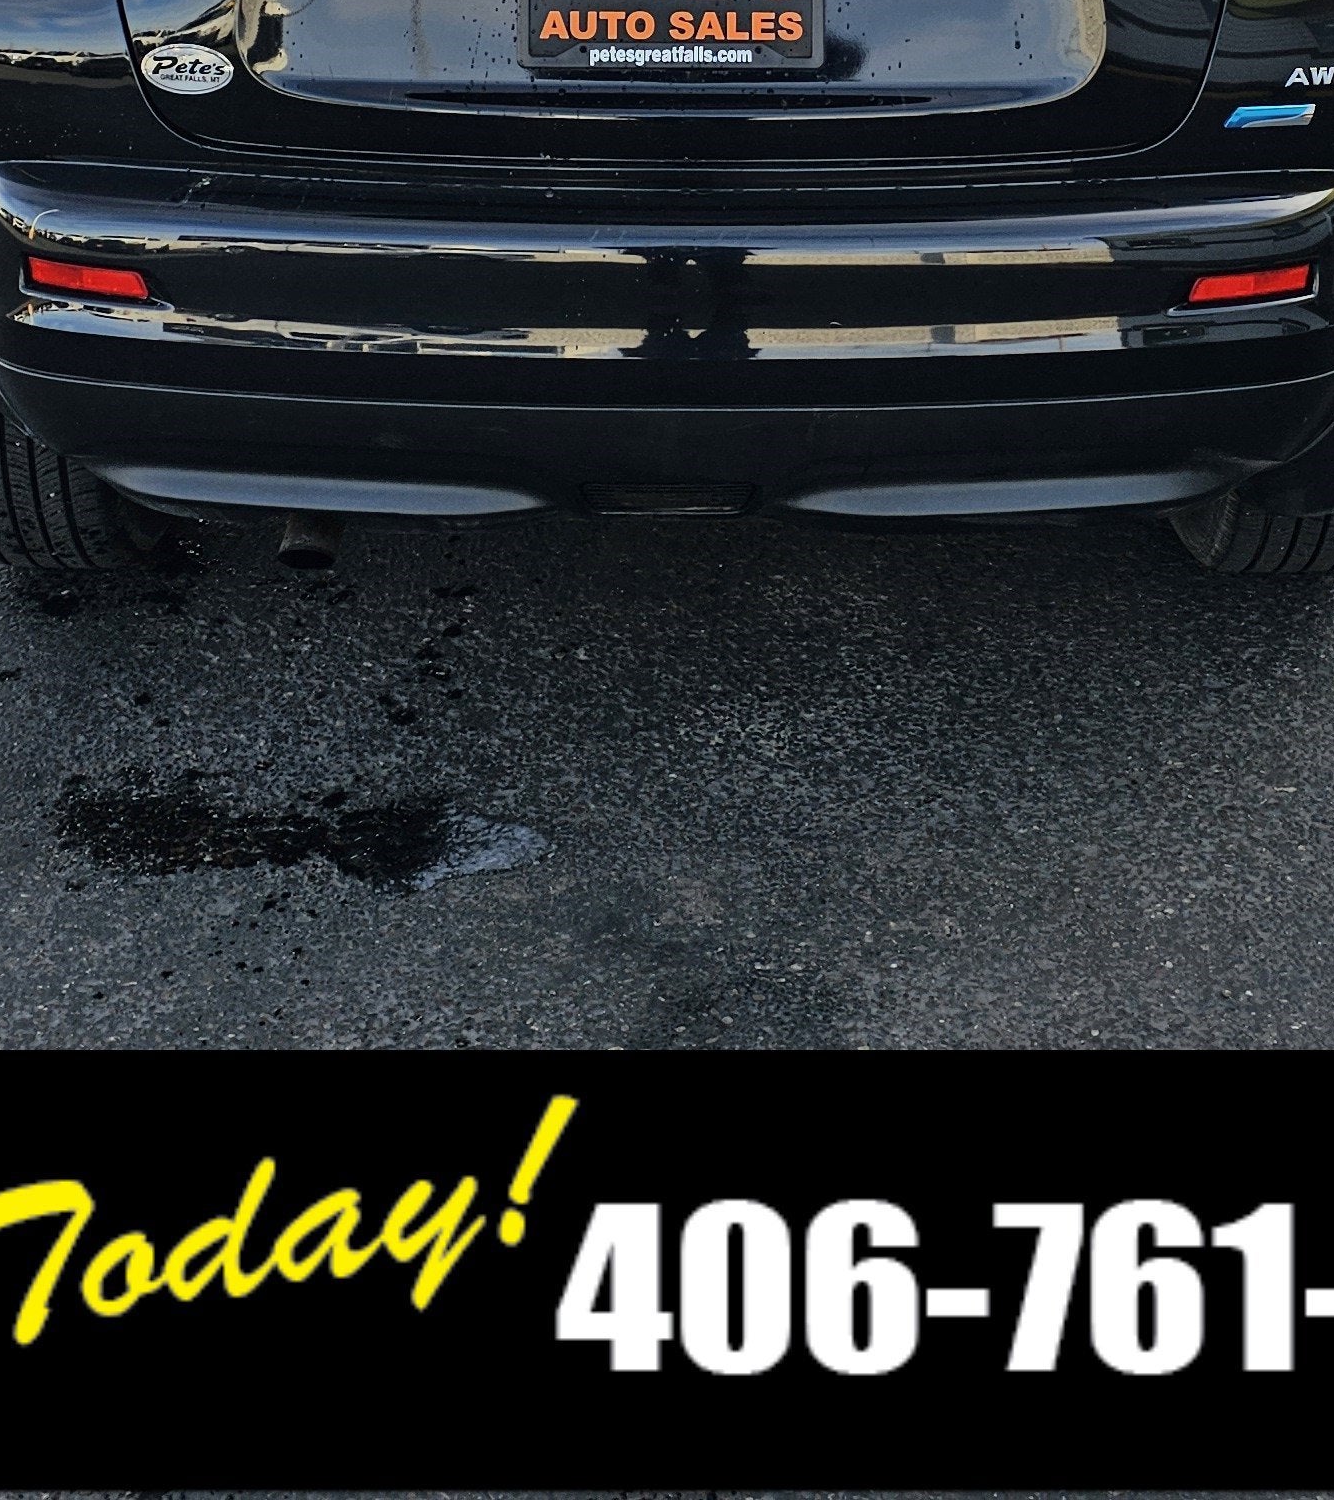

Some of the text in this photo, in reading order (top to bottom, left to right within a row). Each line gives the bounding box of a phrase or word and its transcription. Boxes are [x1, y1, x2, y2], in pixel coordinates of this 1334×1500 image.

[539, 10, 804, 41] AUTO SALES
[152, 55, 226, 76] Pete's
[589, 45, 753, 66] petesgreatfalls.com
